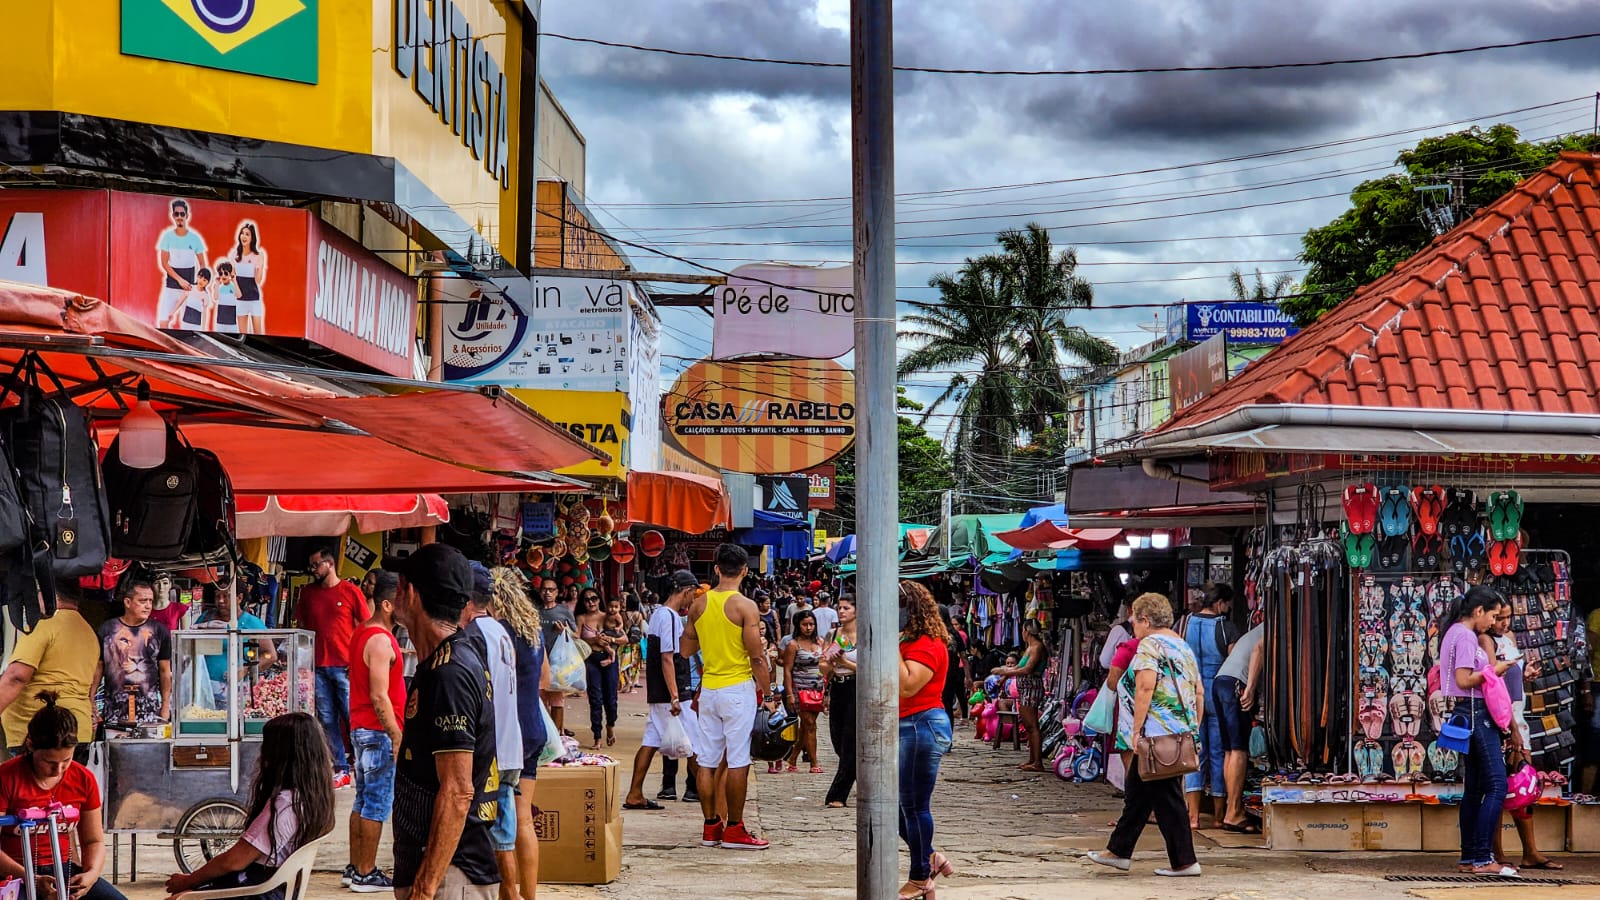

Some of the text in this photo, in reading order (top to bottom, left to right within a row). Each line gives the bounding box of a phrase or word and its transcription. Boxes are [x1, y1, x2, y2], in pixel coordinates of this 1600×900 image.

[314, 240, 411, 360] SKINA DA MODA
[722, 287, 752, 314] Pé
[758, 287, 789, 314] de
[476, 322, 507, 330] Utilidades
[1230, 327, 1286, 338] 99983-7020
[461, 344, 502, 353] Acessórios
[675, 402, 856, 421] CASA RABELO
[684, 427, 715, 435] CALÇADOS
[434, 714, 467, 727] QATAR
